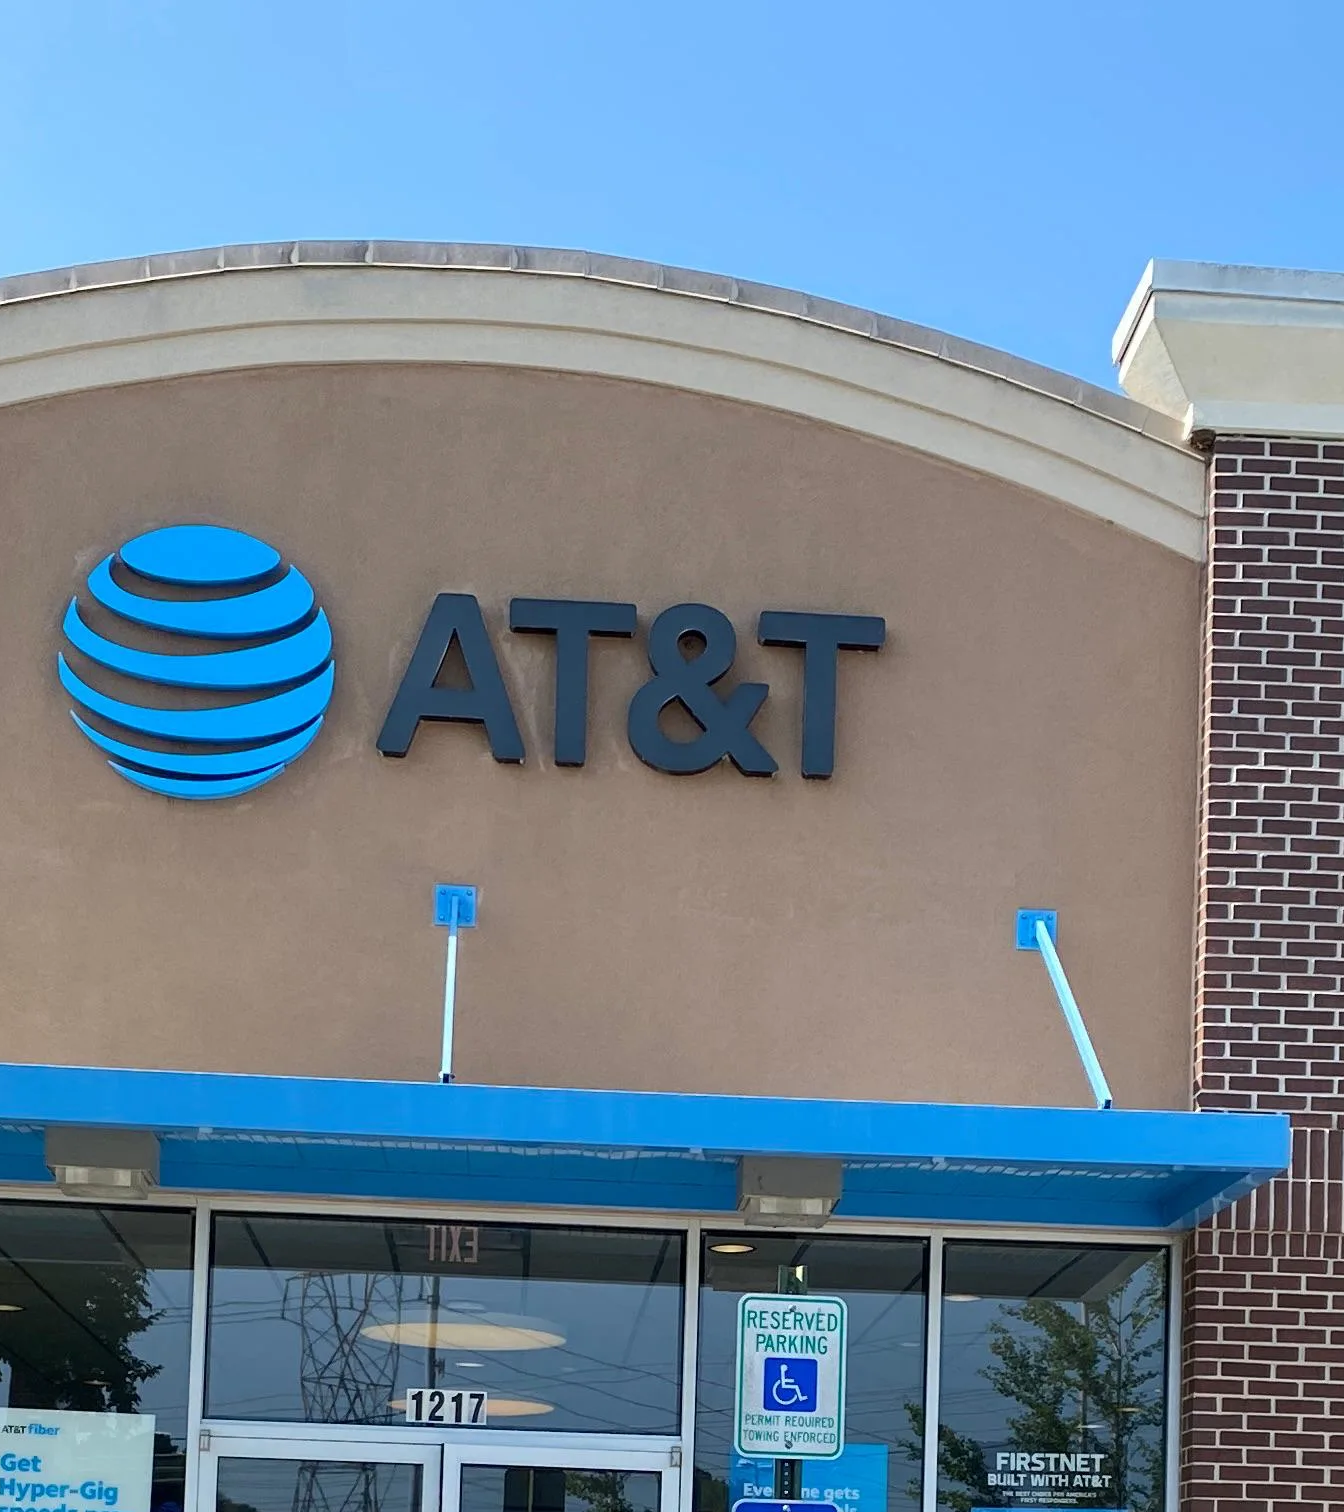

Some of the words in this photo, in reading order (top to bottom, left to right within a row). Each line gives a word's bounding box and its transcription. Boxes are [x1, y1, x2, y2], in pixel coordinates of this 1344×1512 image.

[376, 593, 887, 779] AT&T
[747, 1310, 838, 1332] RESERVED
[756, 1334, 828, 1354] PARKING
[412, 1391, 484, 1423] 1217
[1, 1425, 27, 1434] AT&T
[28, 1423, 60, 1435] fiber
[745, 1414, 781, 1426] PERMIT
[785, 1416, 835, 1429] REQUIRED
[743, 1429, 780, 1442] TOWING
[784, 1431, 836, 1445] ENFORCED
[0, 1453, 42, 1472] Get
[996, 1452, 1105, 1472] FIRSTNET
[987, 1473, 1027, 1486] BUILT
[1030, 1474, 1069, 1487] WITH
[1072, 1475, 1112, 1488] AT&T
[0, 1477, 118, 1506] Hyper-Gig
[743, 1483, 819, 1498] Evene
[824, 1487, 860, 1502] gets
